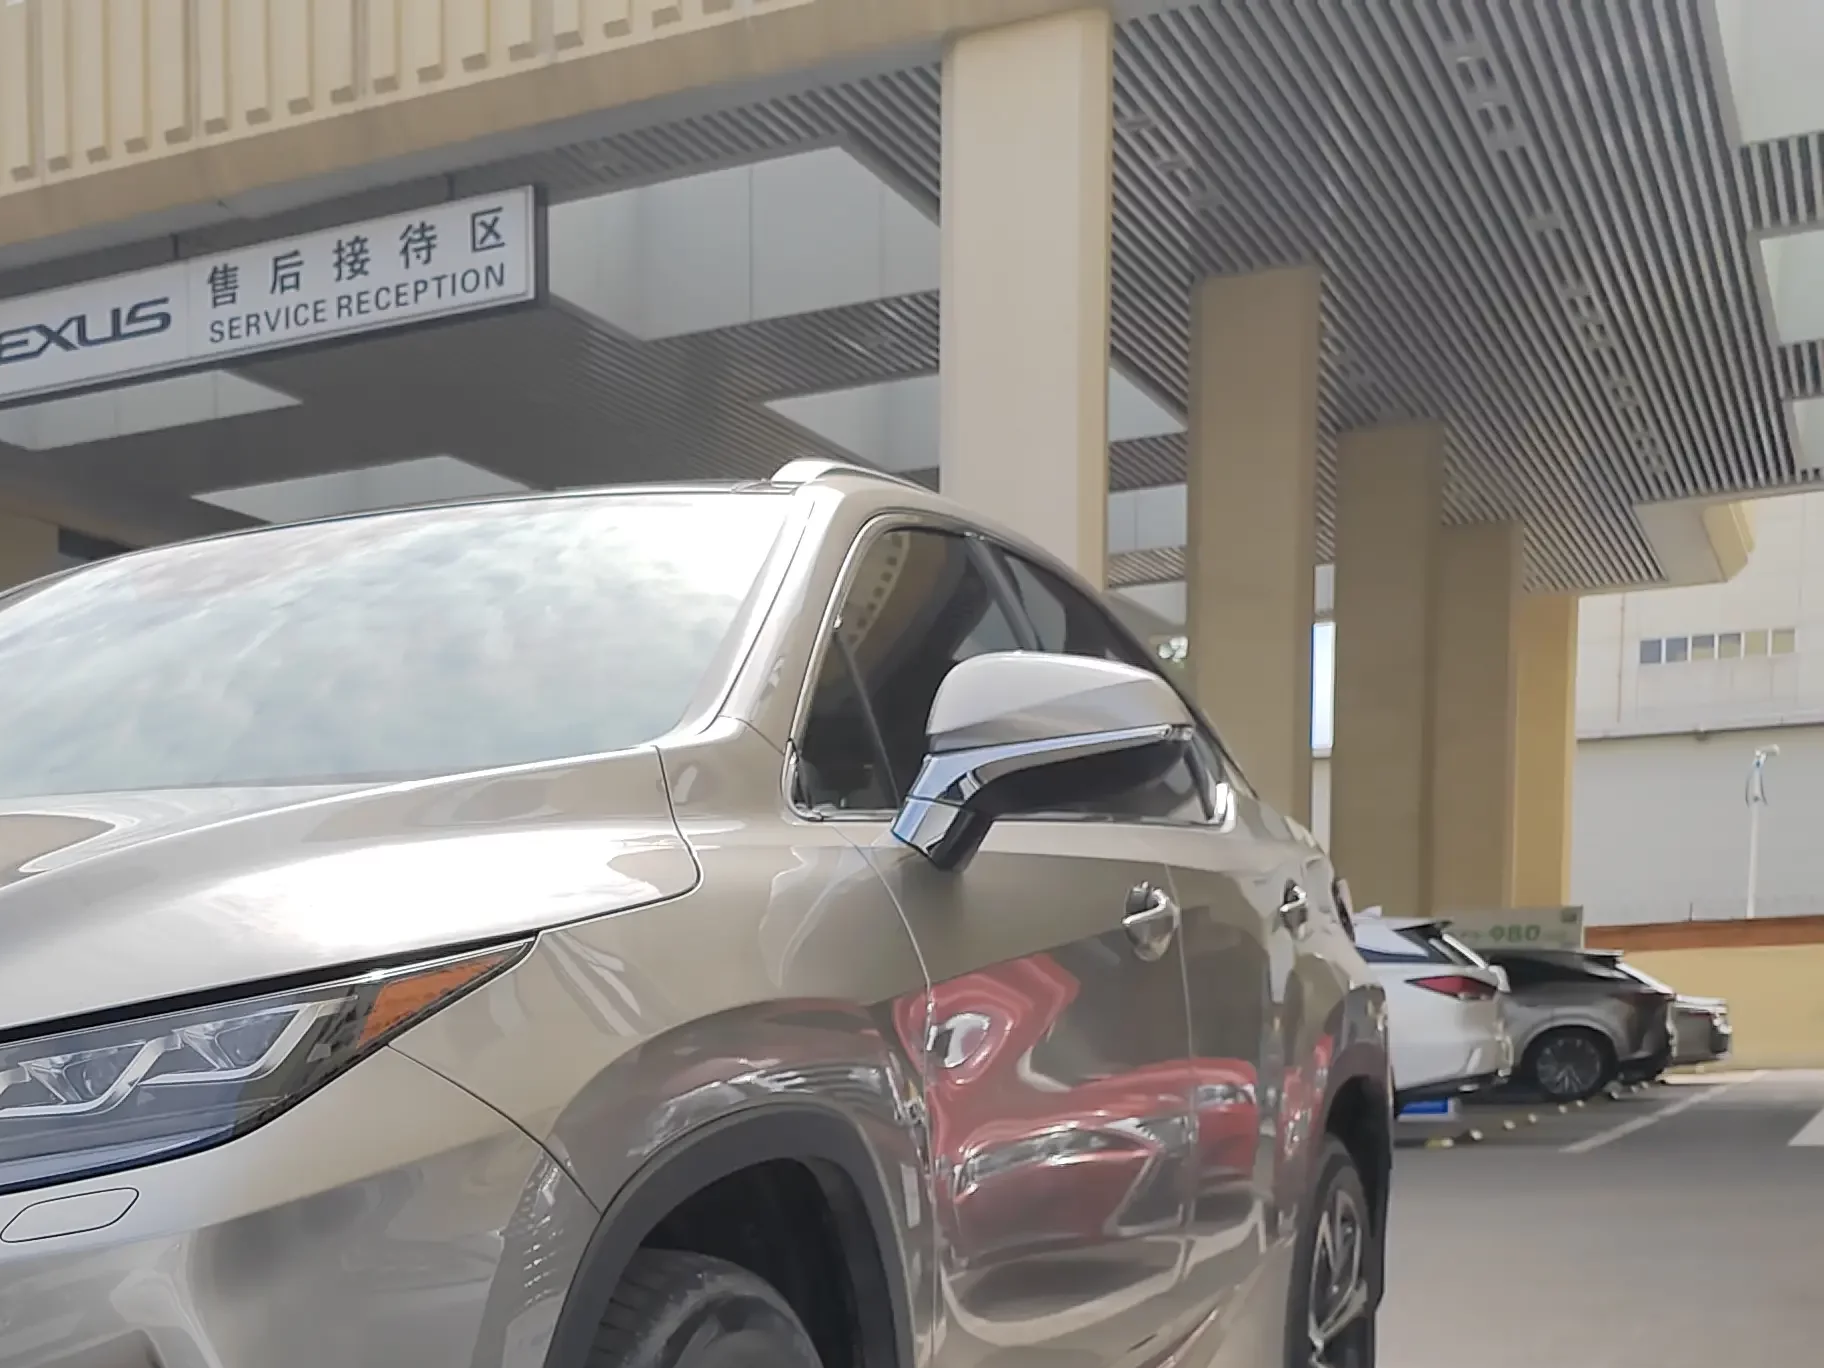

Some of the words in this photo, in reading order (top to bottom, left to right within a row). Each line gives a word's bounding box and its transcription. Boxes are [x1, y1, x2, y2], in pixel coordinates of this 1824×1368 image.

[207, 206, 505, 308] 售后接待区
[209, 299, 327, 343] SERVICE
[337, 262, 505, 320] RECEPTION
